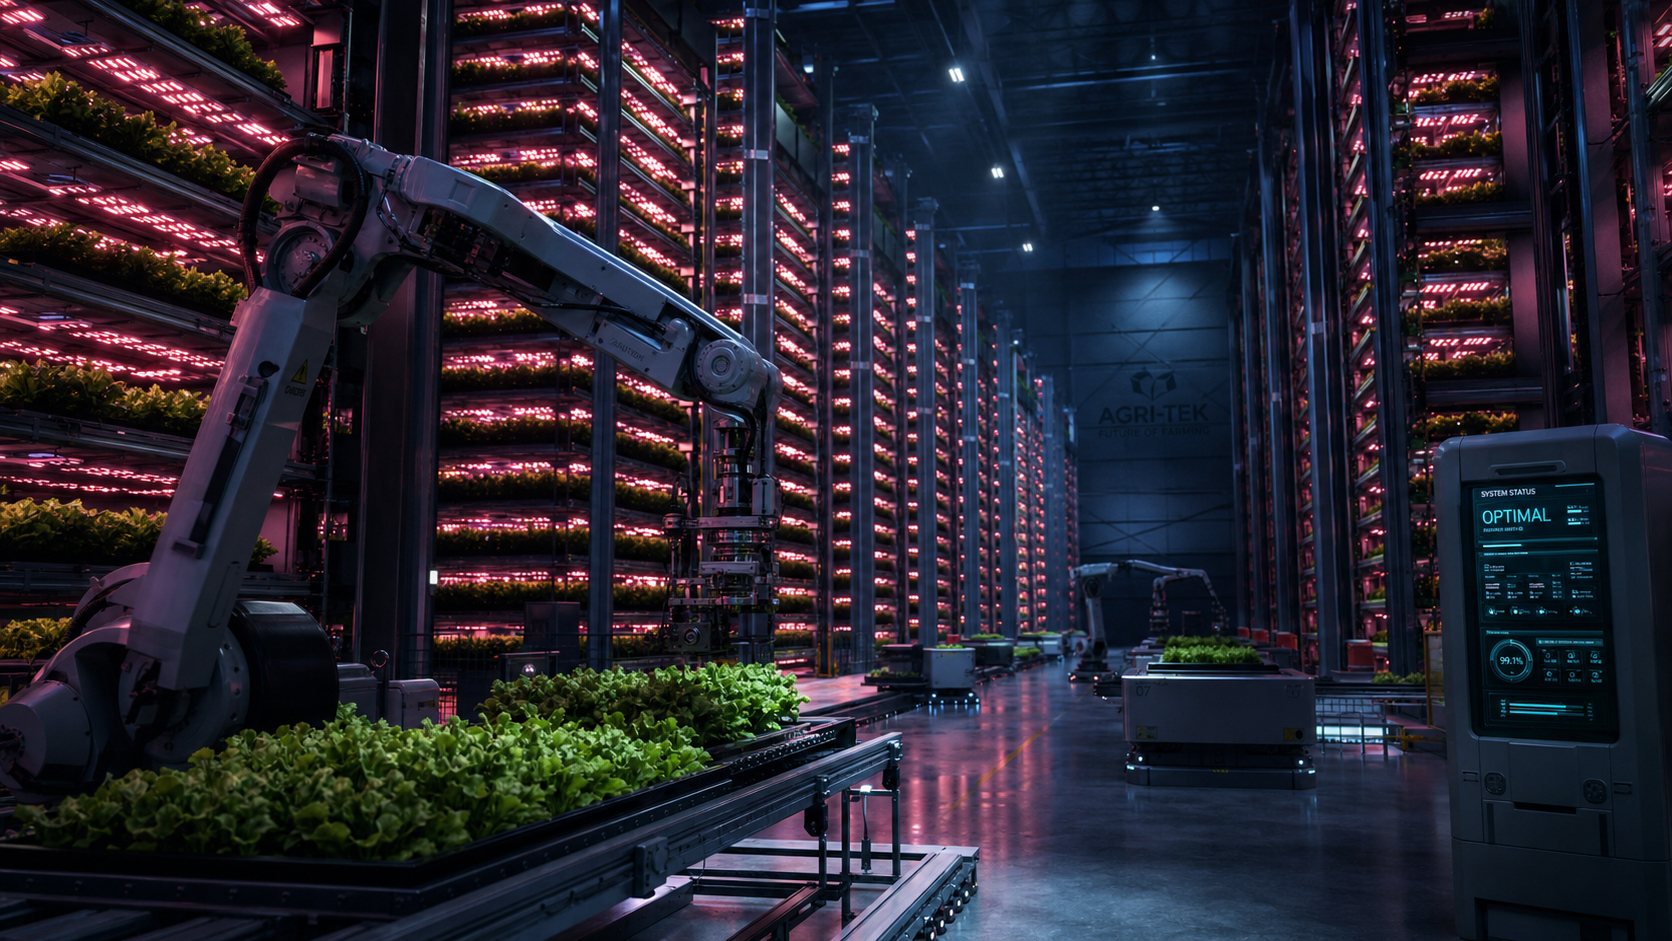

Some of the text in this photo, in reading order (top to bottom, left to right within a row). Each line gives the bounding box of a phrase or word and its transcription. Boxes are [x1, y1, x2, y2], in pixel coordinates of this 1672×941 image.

[1098, 403, 1209, 424] AGRI-TEK
[1098, 426, 1211, 438] FUTURE OF FARMING
[1481, 488, 1536, 498] SYSTEM STATUS
[1482, 507, 1552, 525] OPTIMAL
[1499, 656, 1524, 666] 99.1%
[1136, 685, 1151, 697] 07
